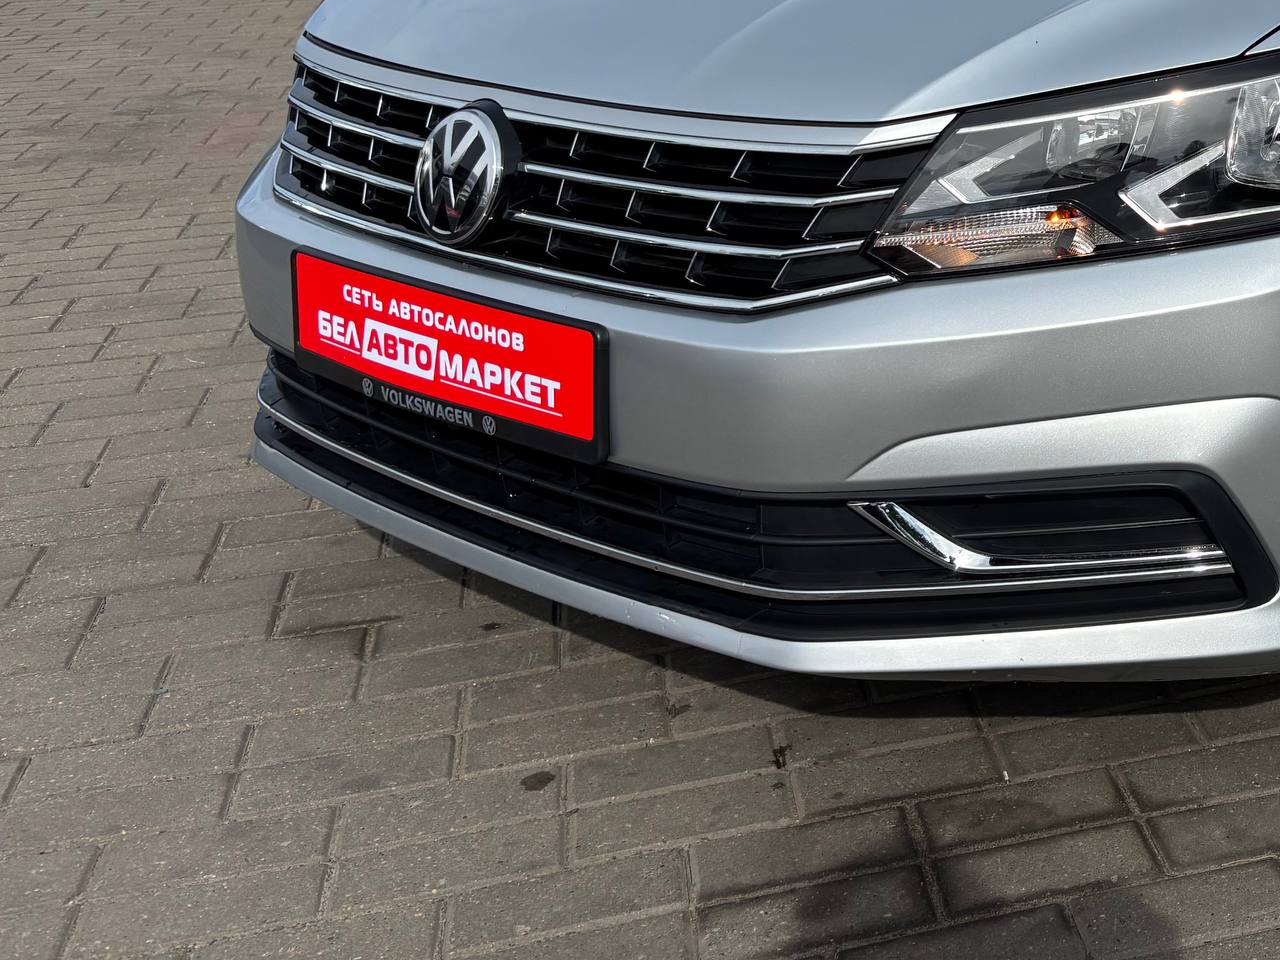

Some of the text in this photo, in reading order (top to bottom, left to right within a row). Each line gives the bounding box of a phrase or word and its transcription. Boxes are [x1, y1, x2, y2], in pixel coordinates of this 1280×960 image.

[342, 283, 525, 352] СЕТЬ АВТОСАЛОНОВ
[380, 385, 474, 428] VOLKSWAGEN
